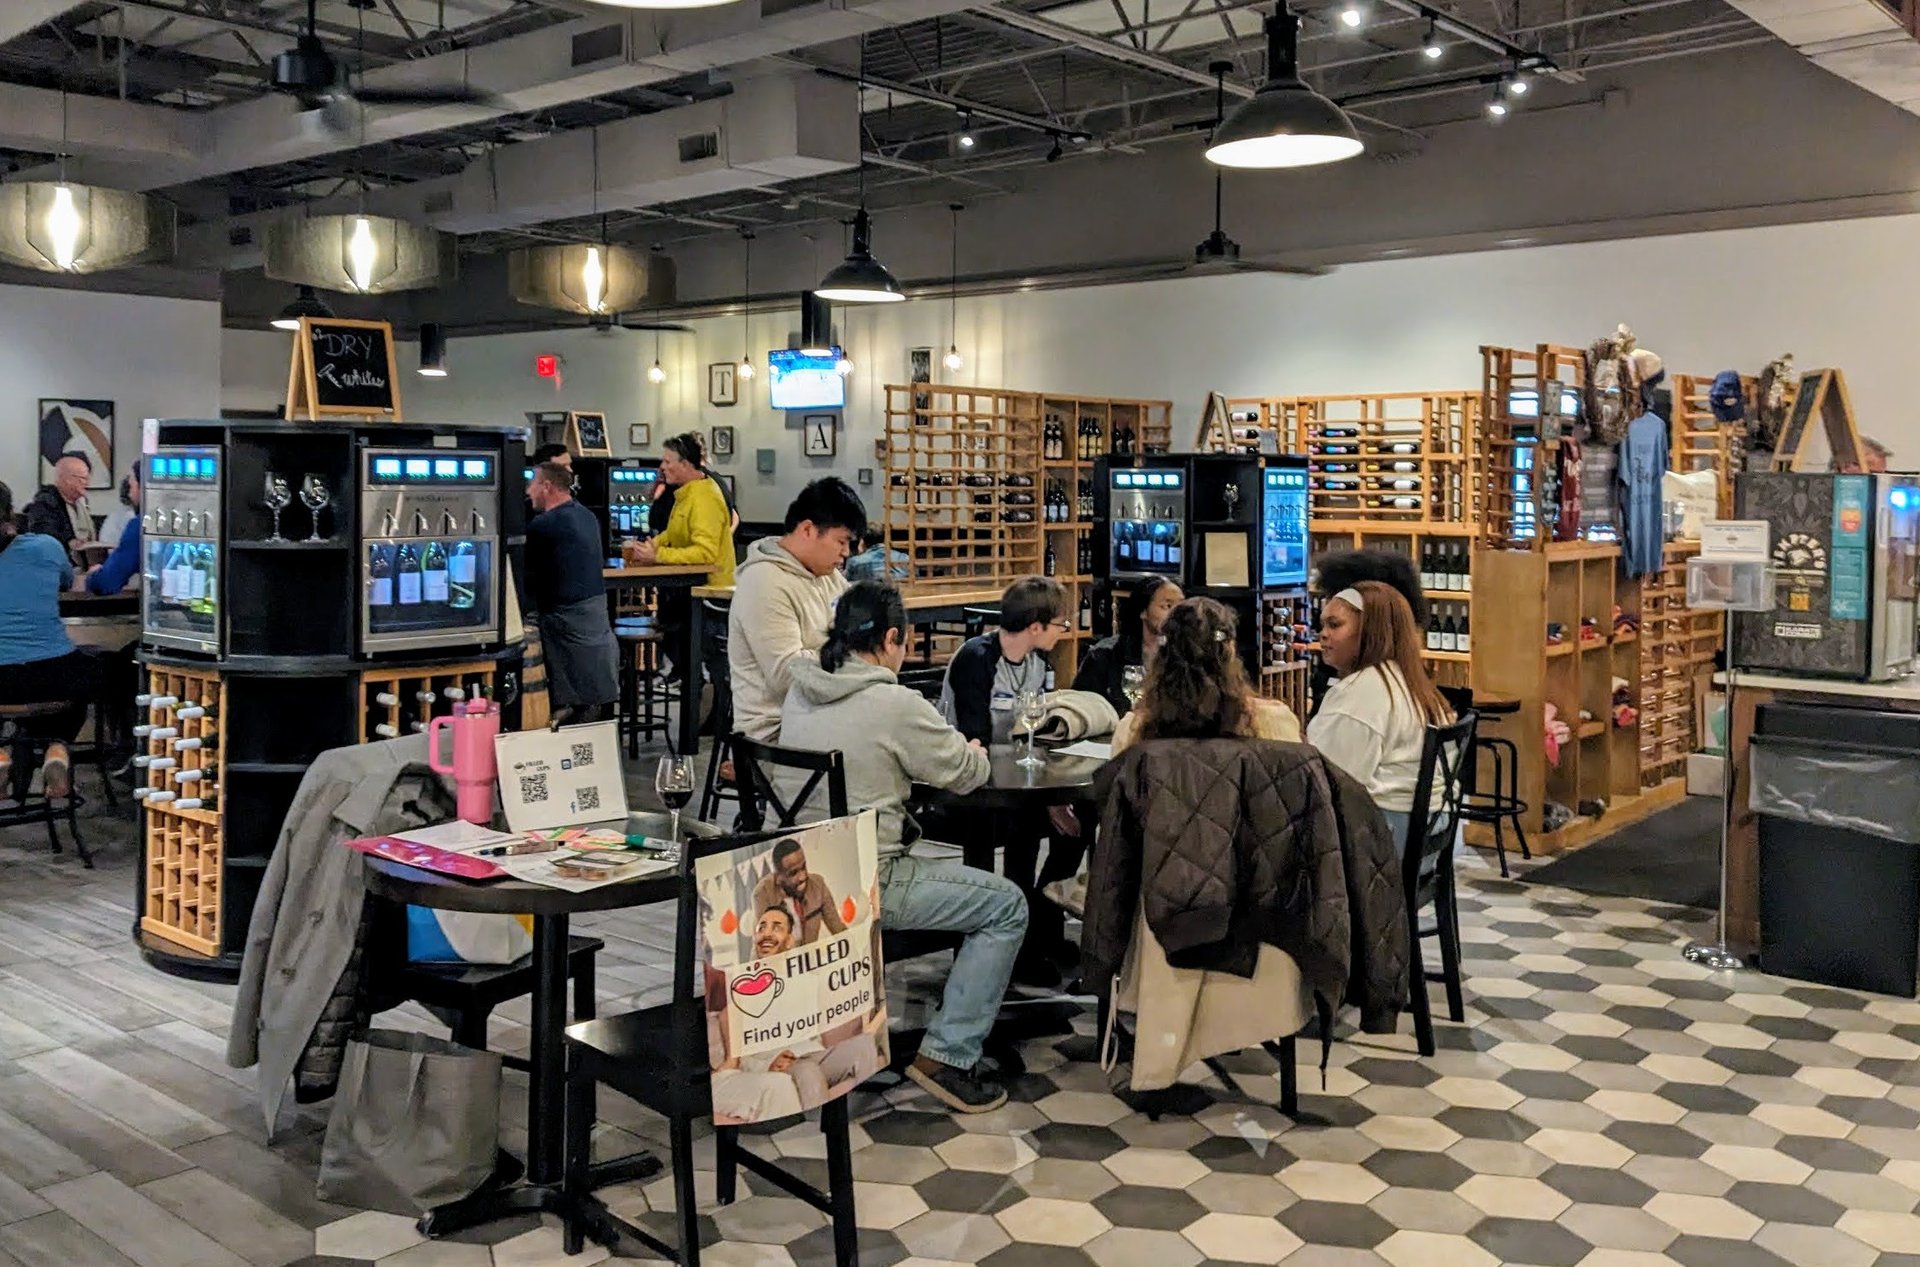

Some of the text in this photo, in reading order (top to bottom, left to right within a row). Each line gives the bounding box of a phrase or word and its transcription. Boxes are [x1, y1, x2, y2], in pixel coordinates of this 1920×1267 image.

[322, 333, 372, 359] DRY
[715, 370, 731, 396] T
[811, 423, 829, 449] A
[785, 938, 850, 978] FILLED
[828, 956, 871, 992] CUPS
[743, 990, 870, 1045] Find your people
